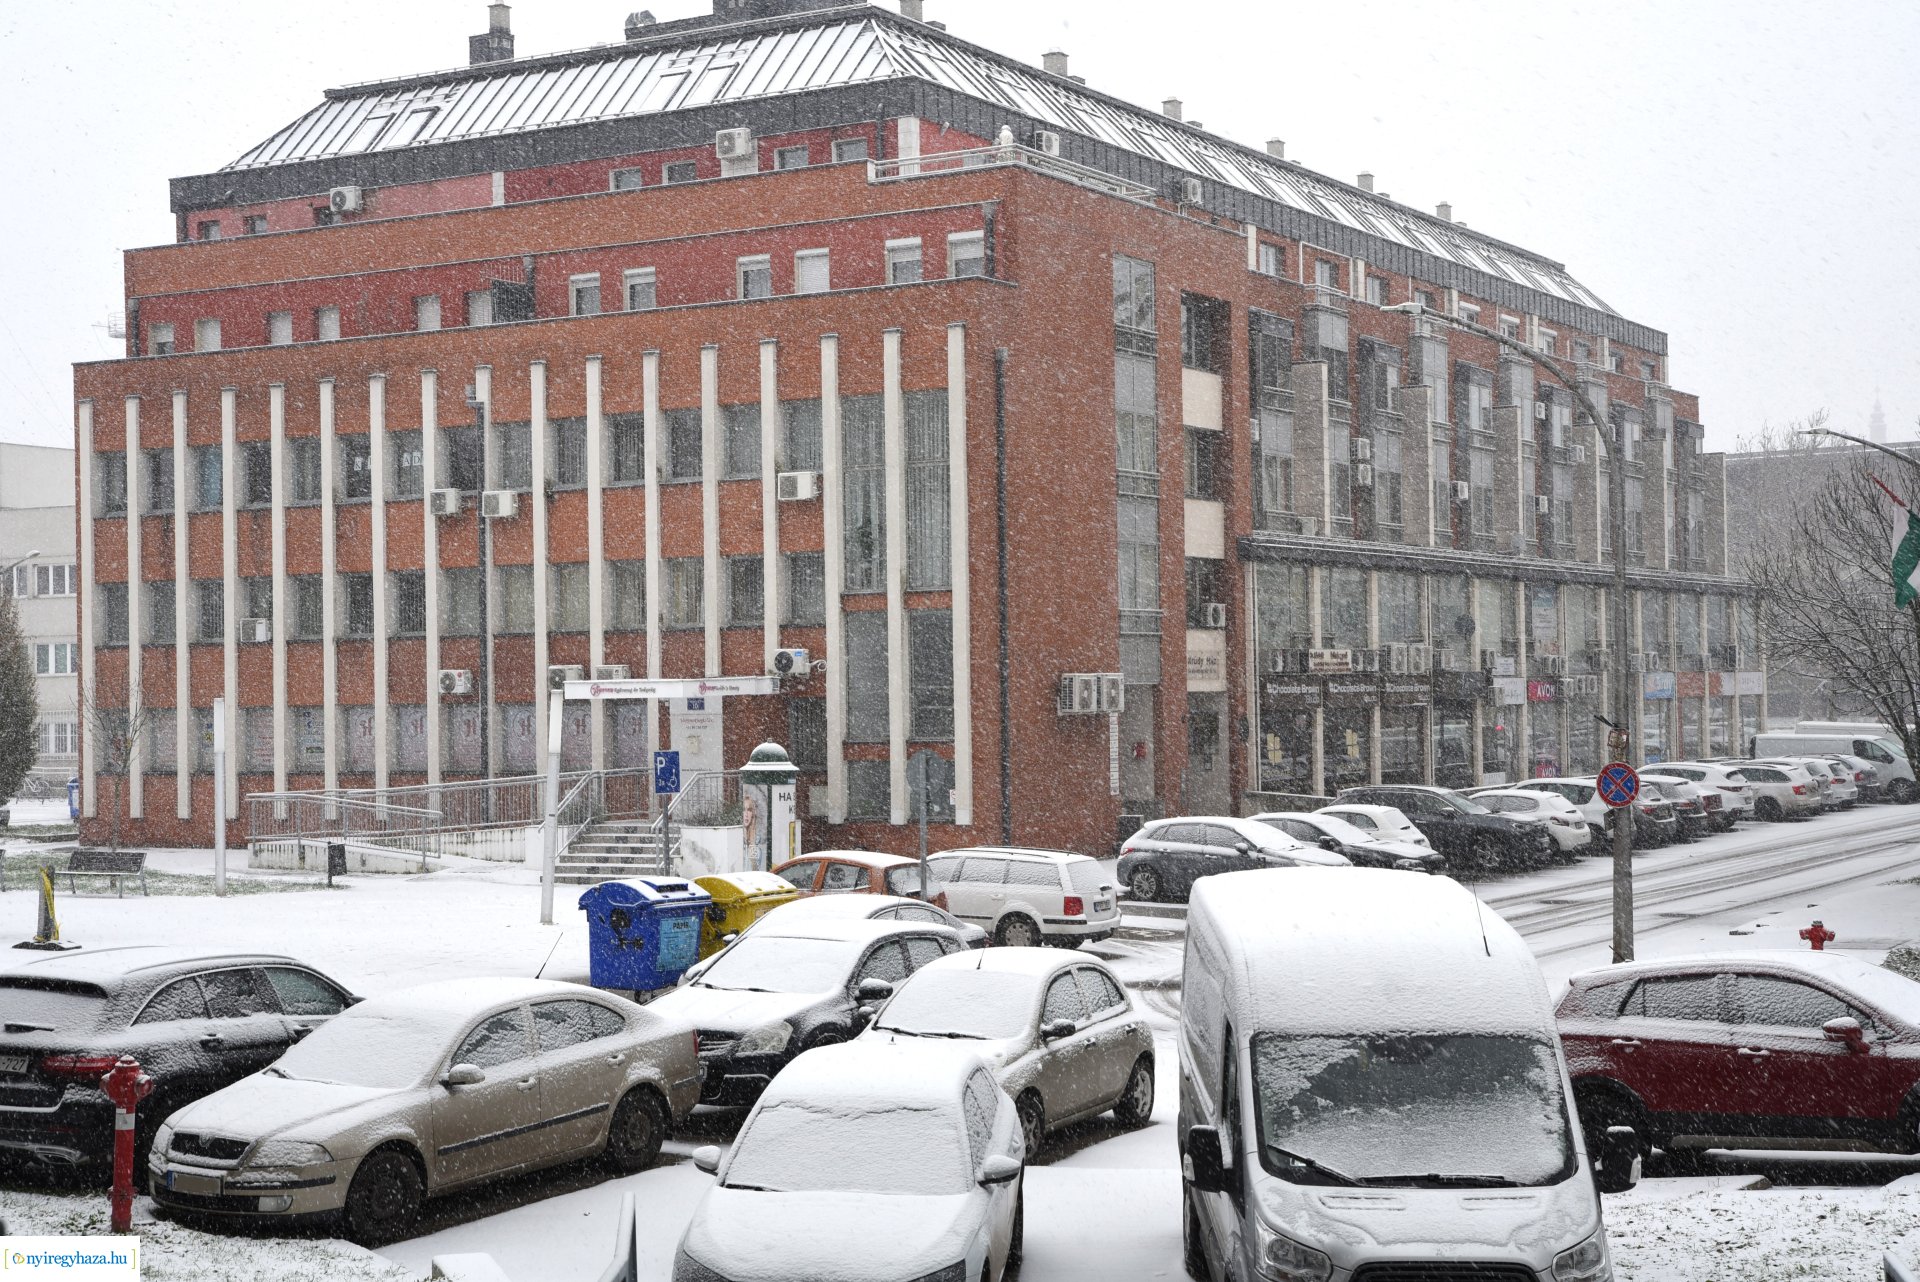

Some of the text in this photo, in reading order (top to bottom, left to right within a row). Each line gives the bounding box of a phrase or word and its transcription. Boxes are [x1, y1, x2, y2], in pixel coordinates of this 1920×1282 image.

[1302, 684, 1320, 694] Brown
[1536, 683, 1556, 698] AVON
[656, 756, 666, 775] P
